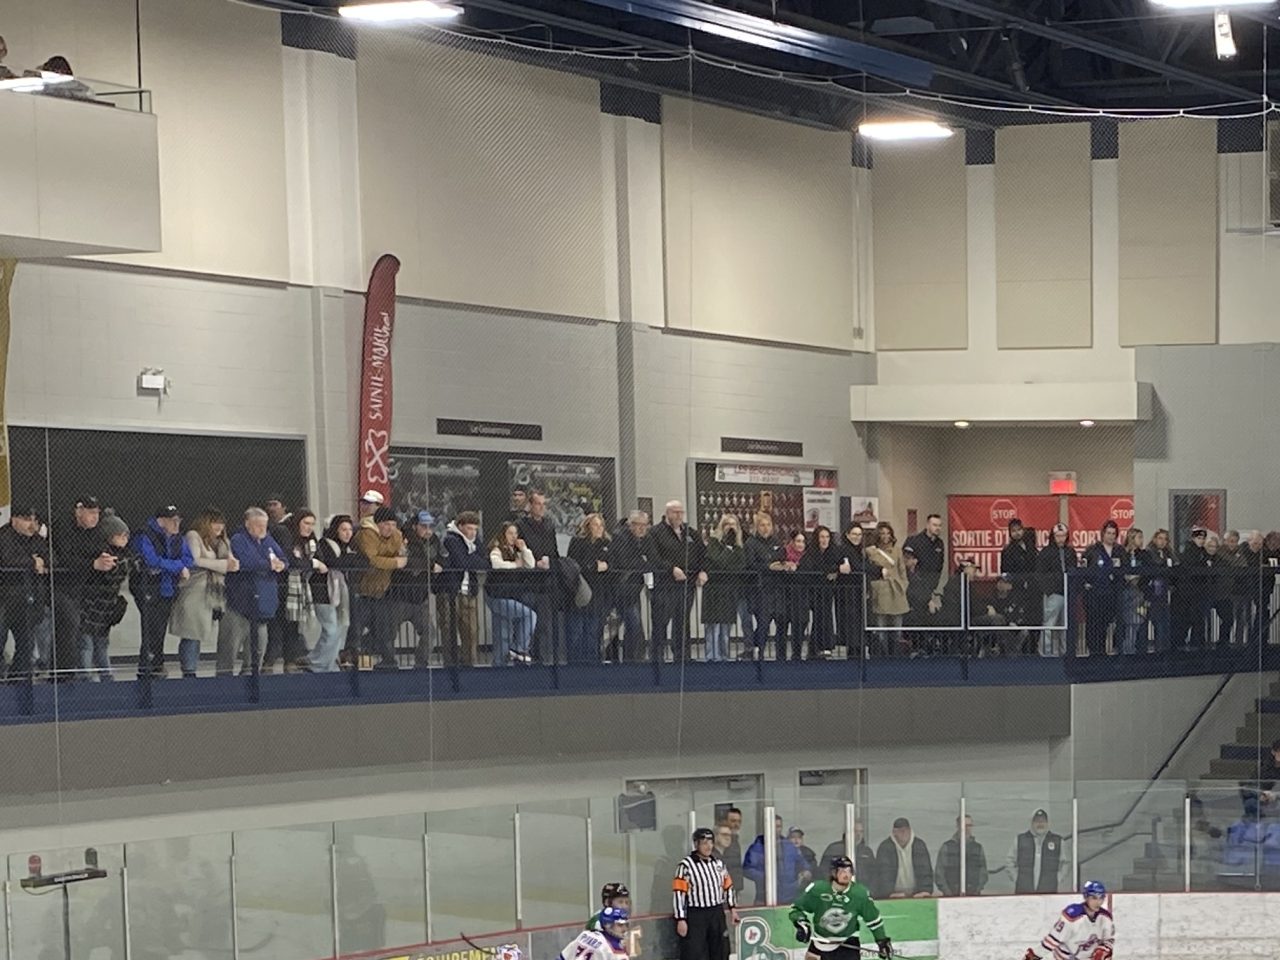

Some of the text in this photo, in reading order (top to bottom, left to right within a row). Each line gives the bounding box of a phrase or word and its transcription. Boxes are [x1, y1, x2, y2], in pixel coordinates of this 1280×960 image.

[991, 508, 1016, 519] STOP
[1111, 508, 1135, 519] STOP
[952, 530, 992, 547] SORTIE
